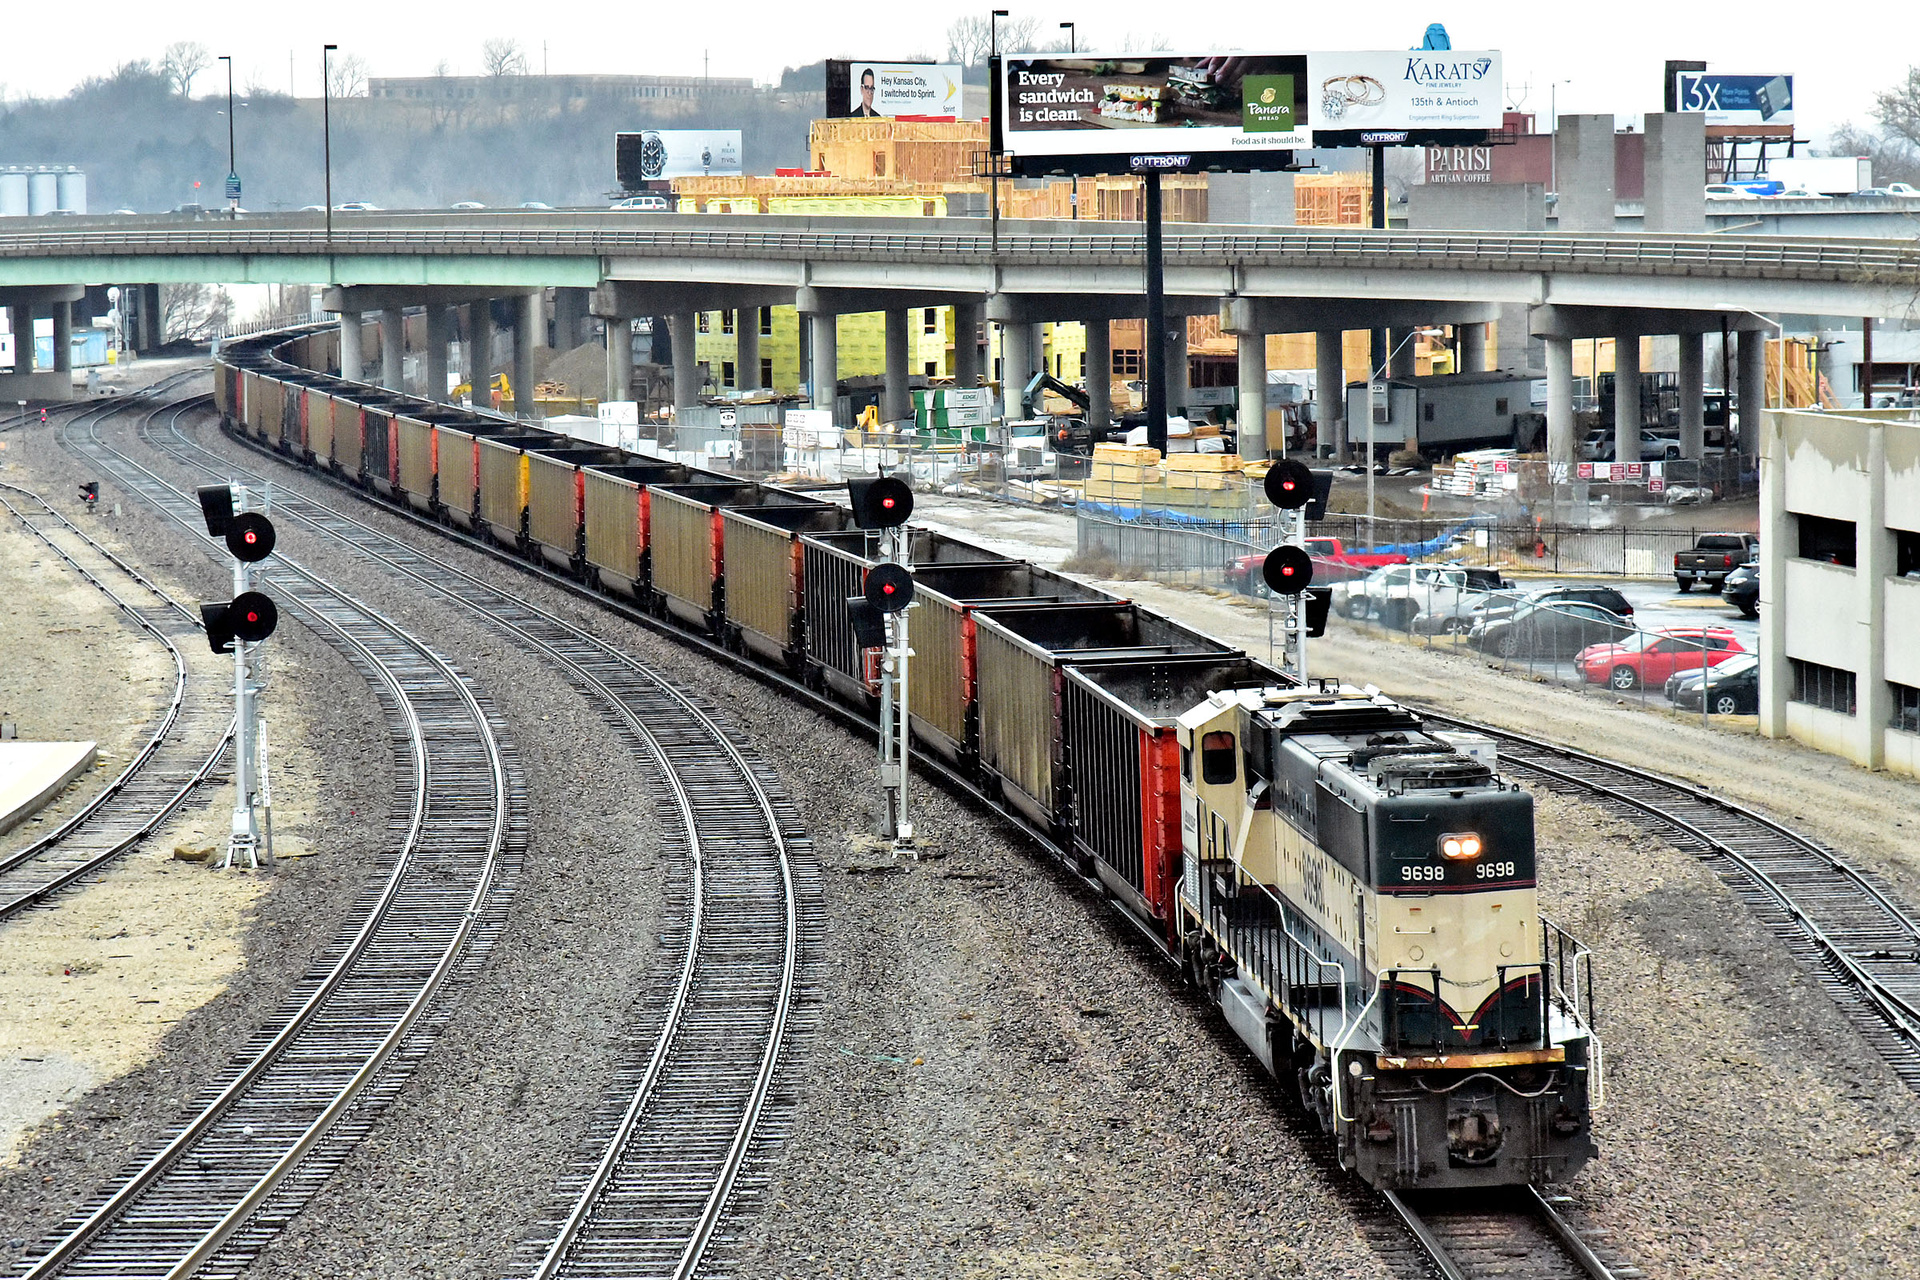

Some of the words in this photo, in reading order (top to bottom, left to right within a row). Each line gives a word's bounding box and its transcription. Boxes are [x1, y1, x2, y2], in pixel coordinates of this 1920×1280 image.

[1403, 58, 1483, 85] KARATS
[881, 77, 892, 86] Hey
[893, 77, 913, 86] Kansas
[914, 76, 927, 87] City,
[1018, 71, 1065, 87] Every
[884, 89, 910, 98] switched
[911, 90, 917, 98] to
[917, 90, 936, 100] Sprint.
[1019, 88, 1094, 104] sandwich
[1411, 98, 1433, 106] 135th
[1436, 98, 1443, 106] &
[1446, 98, 1479, 106] Antioch
[1019, 108, 1034, 122] is
[1035, 107, 1082, 121] clean.
[1247, 103, 1290, 115] Panera
[1231, 137, 1250, 145] Food
[1261, 137, 1267, 145] it
[1294, 136, 1306, 144] be.
[1362, 133, 1405, 141] OUTFRONT
[1132, 156, 1188, 167] OUTFRONT
[1429, 147, 1491, 172] PARISI
[1463, 173, 1491, 182] COFFEE
[1401, 865, 1444, 881] 9698
[1476, 861, 1515, 879] 9698
[1302, 850, 1323, 913] 9698
